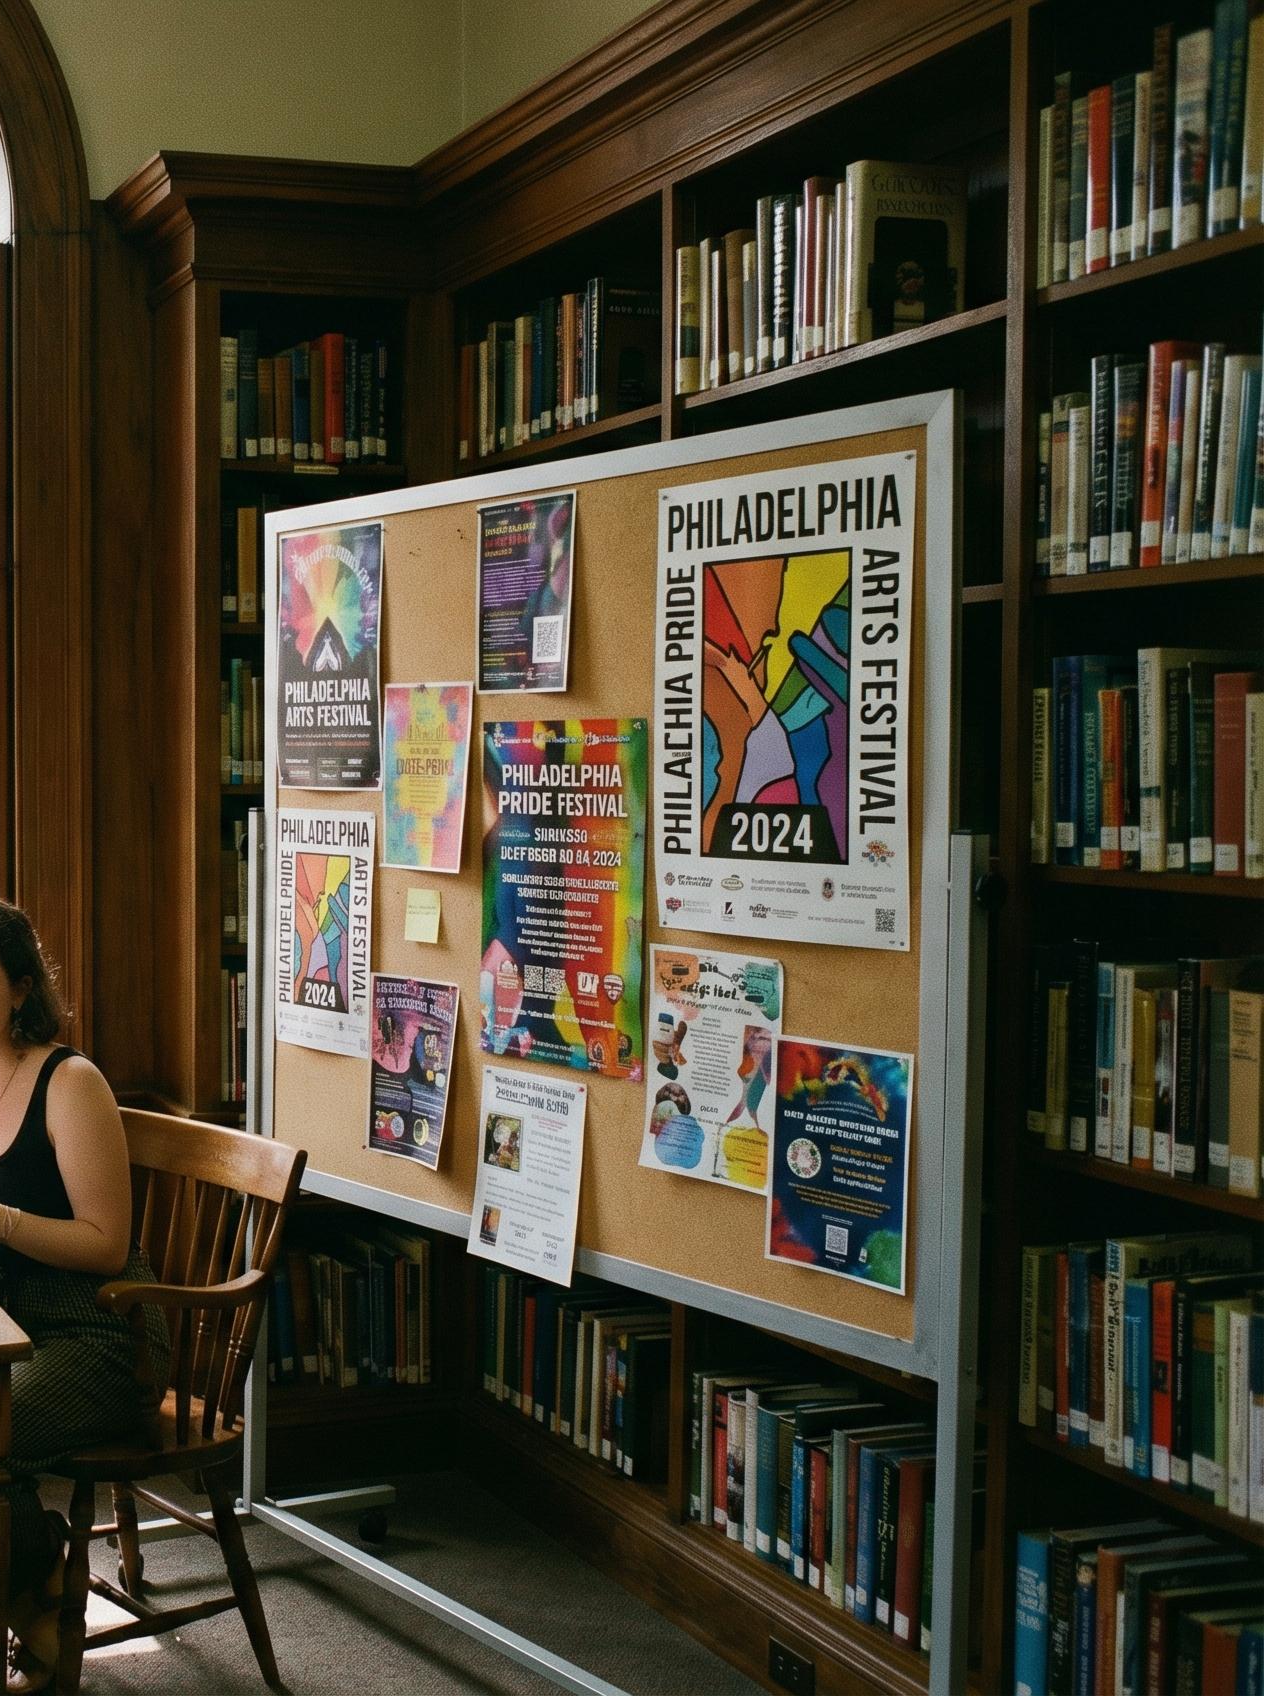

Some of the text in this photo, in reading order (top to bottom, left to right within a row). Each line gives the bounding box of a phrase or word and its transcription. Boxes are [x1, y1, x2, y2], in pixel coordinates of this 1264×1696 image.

[668, 474, 902, 553] PHILADELPHIA
[665, 565, 695, 662] PRIDE
[285, 678, 371, 704] PHILADELPHIA
[859, 548, 900, 835] ARTS FESTIVAL
[285, 704, 372, 728] ARTS FESTIVAL
[501, 764, 623, 788] PHILADELPHIA
[498, 791, 628, 818] PRIDE FESTIVAL
[281, 818, 370, 848] PHILADELPHIA
[731, 812, 813, 855] 2024
[281, 850, 293, 898] PRIDE
[352, 856, 368, 1001] ARTS FESTIVAL
[304, 981, 336, 1008] 2024
